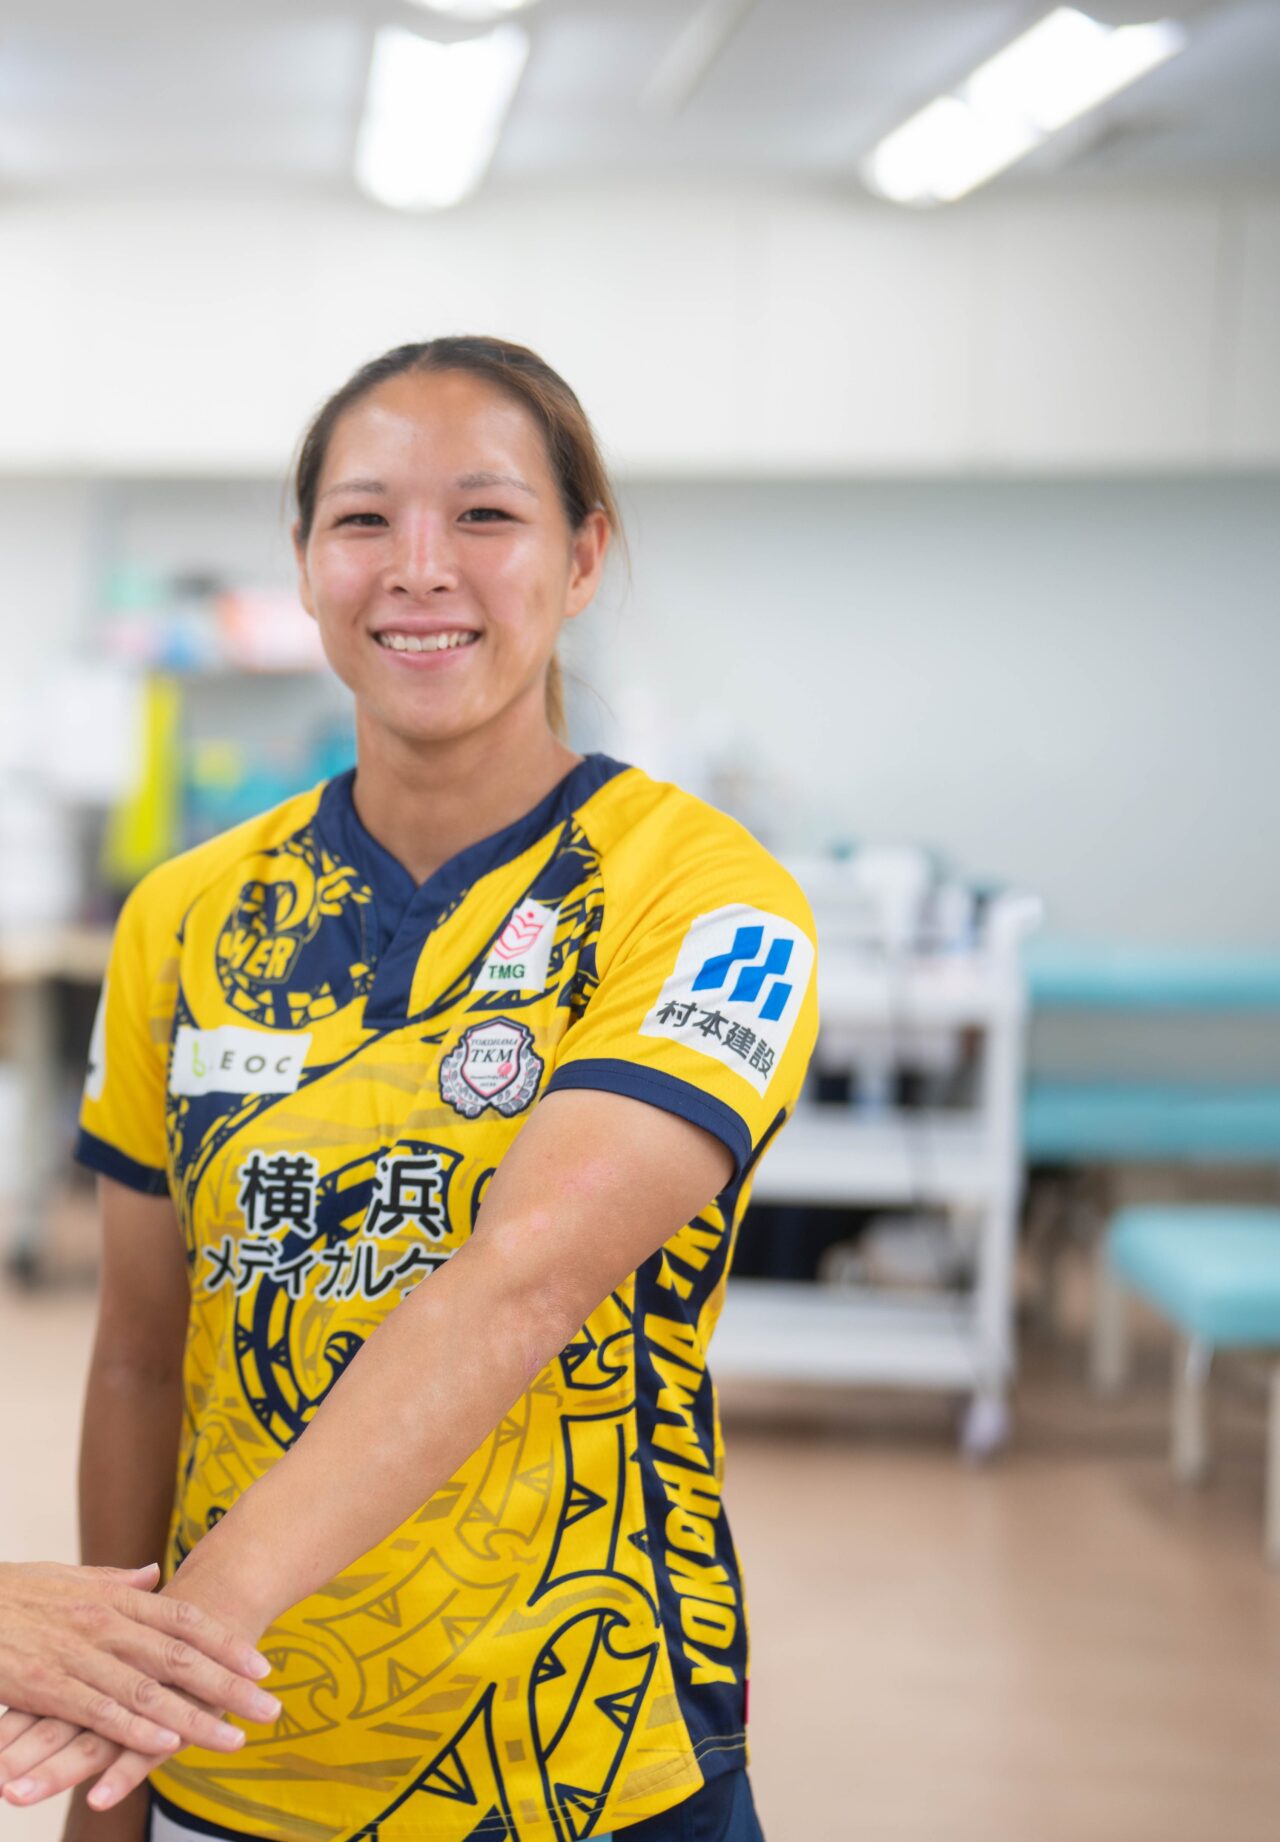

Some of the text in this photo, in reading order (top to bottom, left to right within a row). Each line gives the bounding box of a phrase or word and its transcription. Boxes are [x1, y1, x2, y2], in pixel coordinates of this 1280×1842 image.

[488, 963, 526, 980] TMG
[471, 1047, 514, 1063] TKM
[655, 999, 776, 1080] 村本建設
[239, 1154, 443, 1239] 横浜
